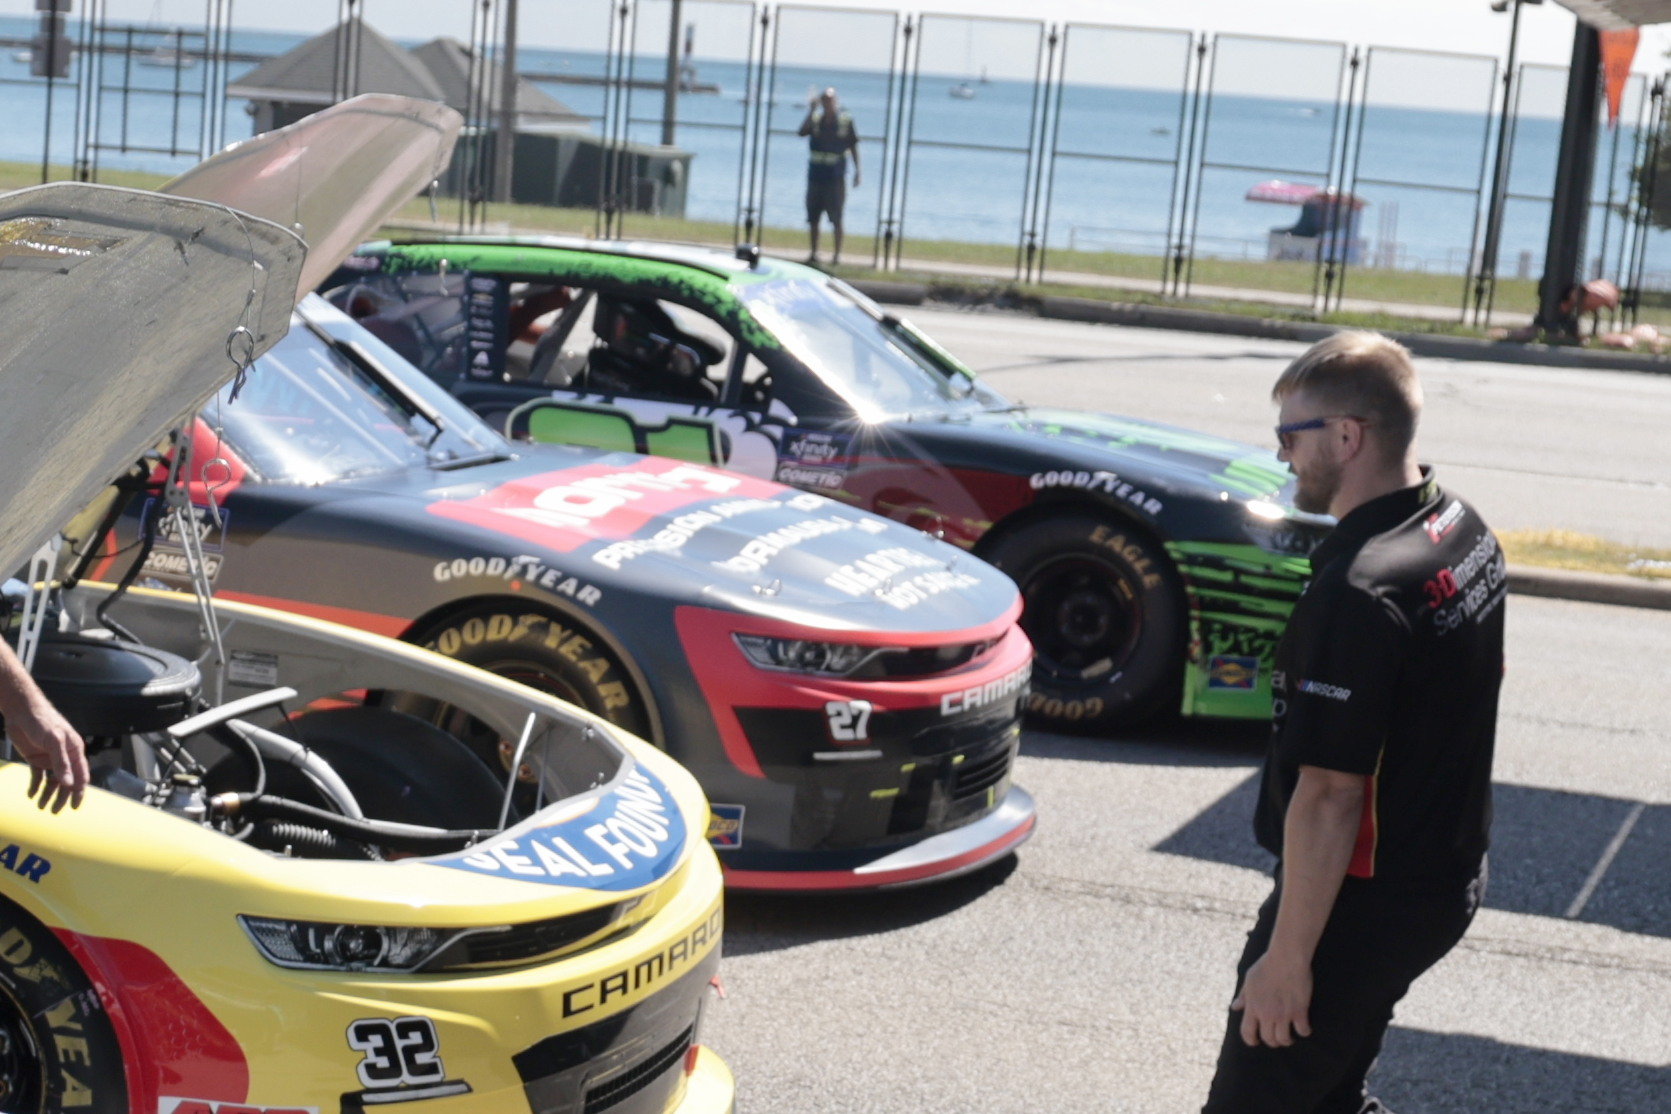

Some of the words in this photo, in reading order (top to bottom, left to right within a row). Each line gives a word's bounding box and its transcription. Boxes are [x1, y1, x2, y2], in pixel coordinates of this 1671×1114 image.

[1305, 680, 1352, 702] NASCAR
[826, 700, 873, 741] 27
[561, 907, 724, 1019] CAMARO
[346, 1015, 446, 1089] 32
